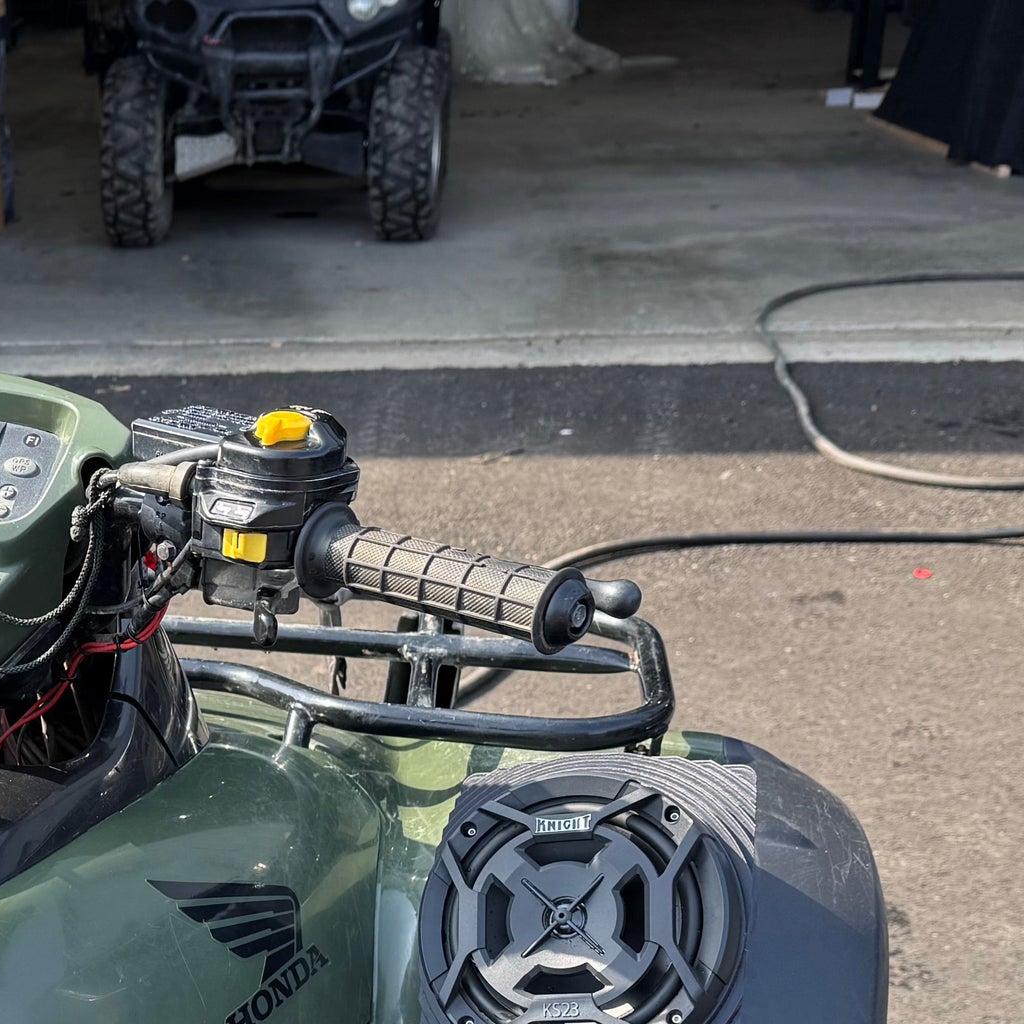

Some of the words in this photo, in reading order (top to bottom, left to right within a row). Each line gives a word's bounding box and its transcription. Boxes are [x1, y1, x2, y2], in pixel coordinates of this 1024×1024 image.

[25, 435, 40, 446] FI
[12, 458, 31, 466] GPS
[537, 815, 591, 832] KNIGHT
[542, 1001, 581, 1018] KS23
